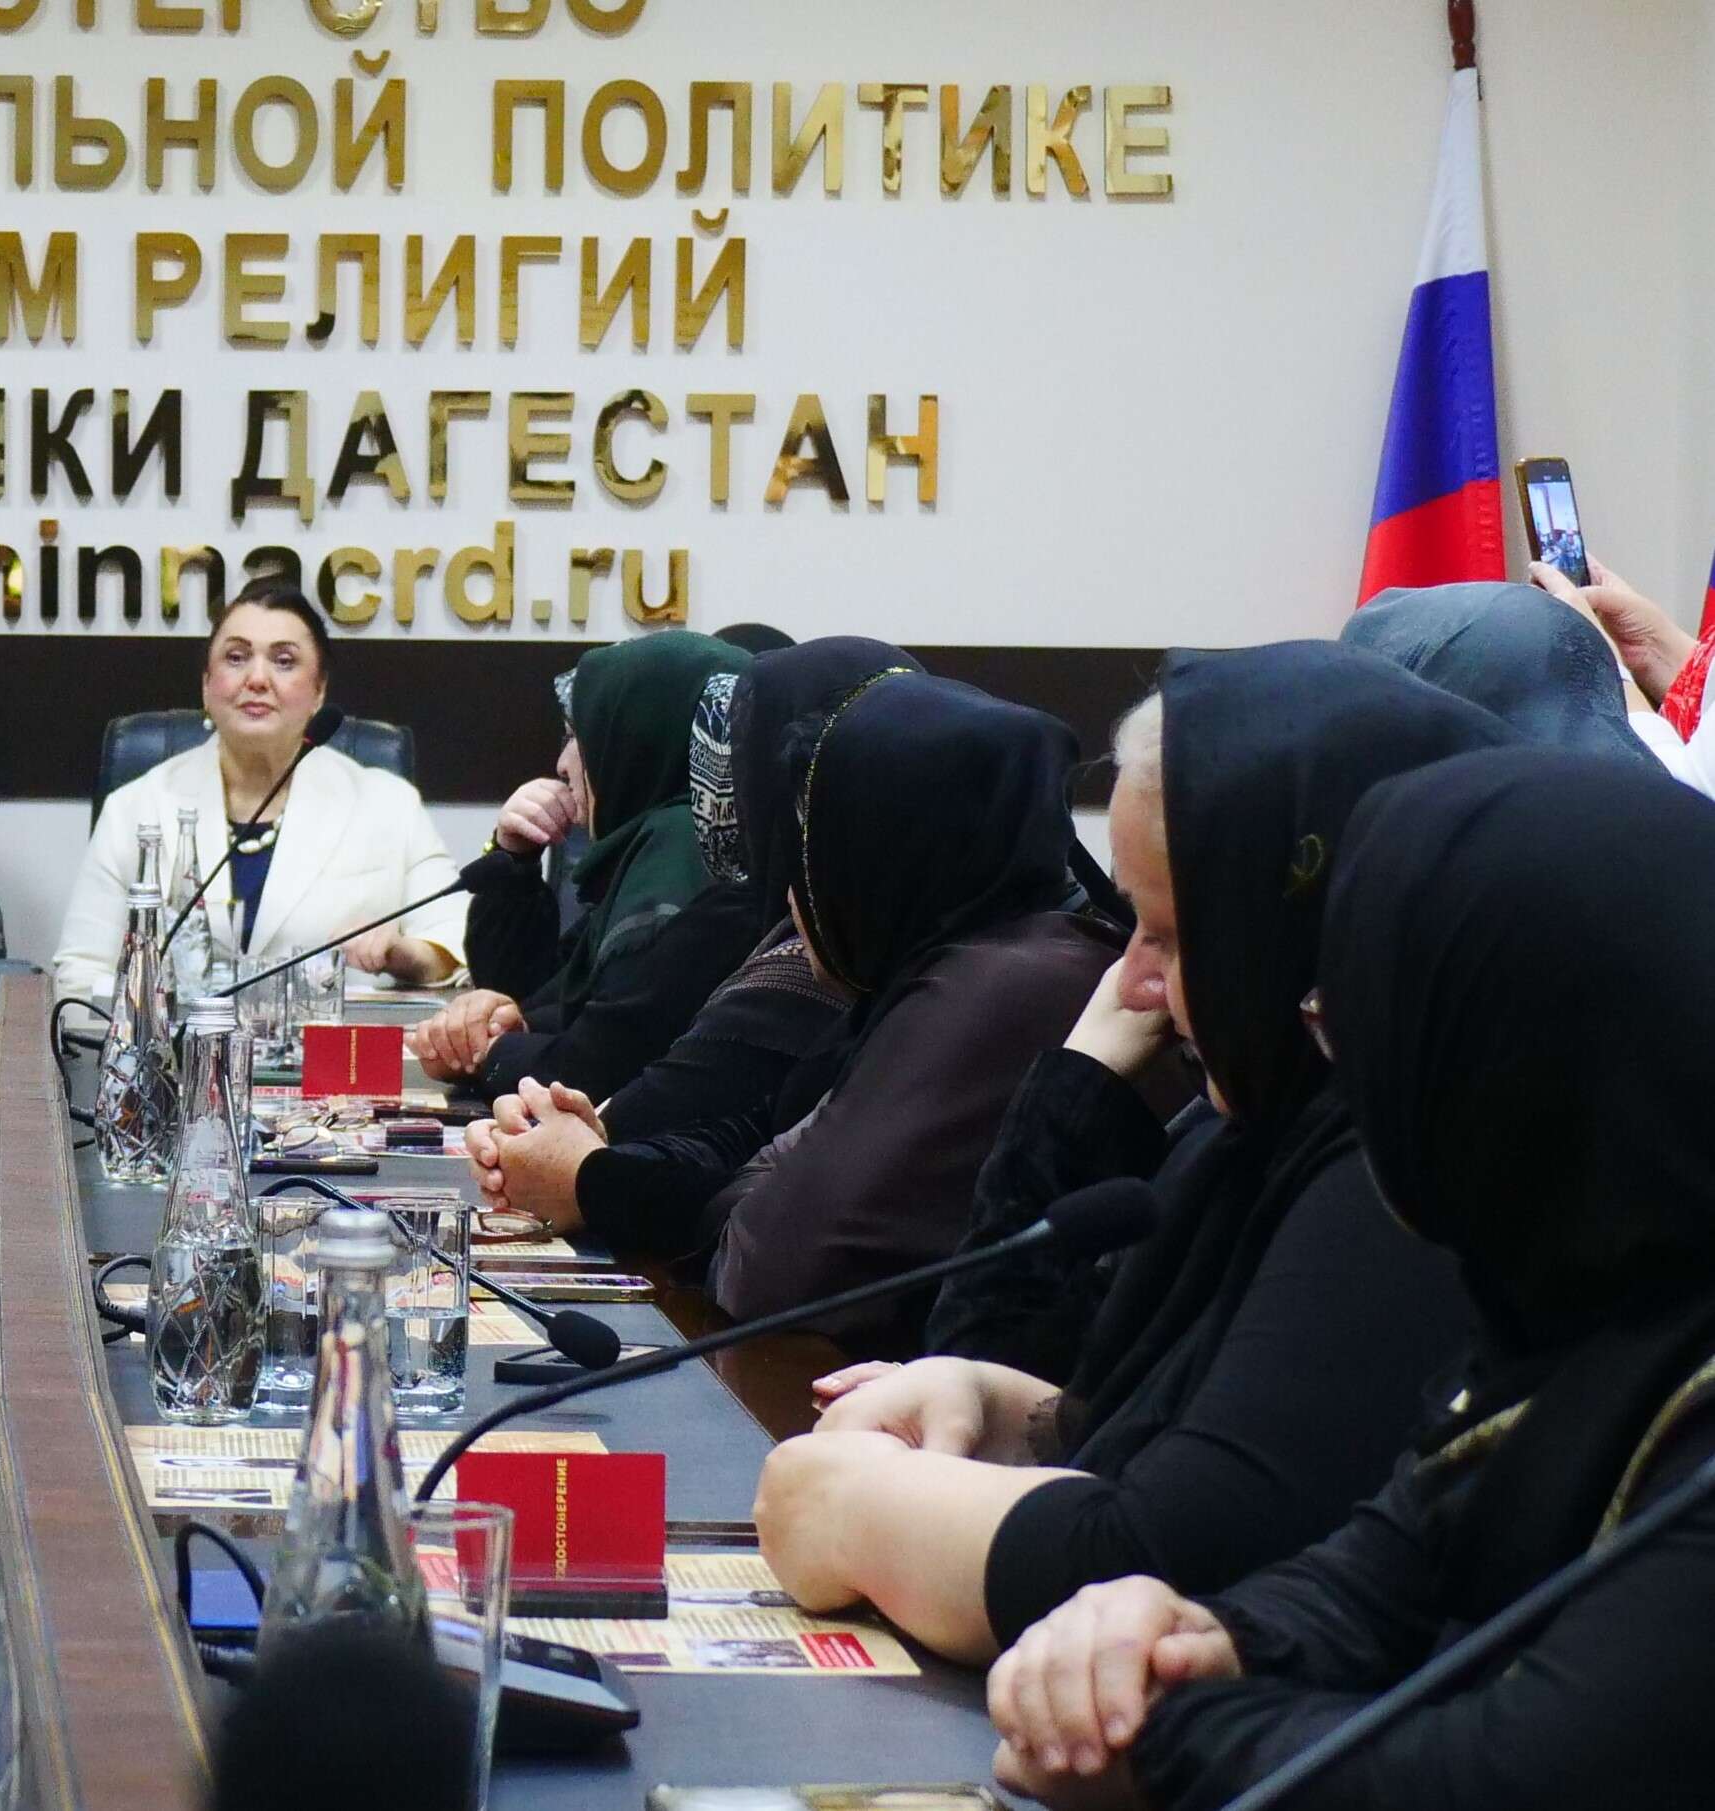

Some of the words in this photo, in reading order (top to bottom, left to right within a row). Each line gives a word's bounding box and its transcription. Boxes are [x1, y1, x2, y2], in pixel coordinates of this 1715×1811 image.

[490, 78, 1174, 196] ПОЛИТИКЕ
[134, 208, 748, 350] РЕЛИГИЙ
[231, 389, 940, 522] ДАГЕСТАН
